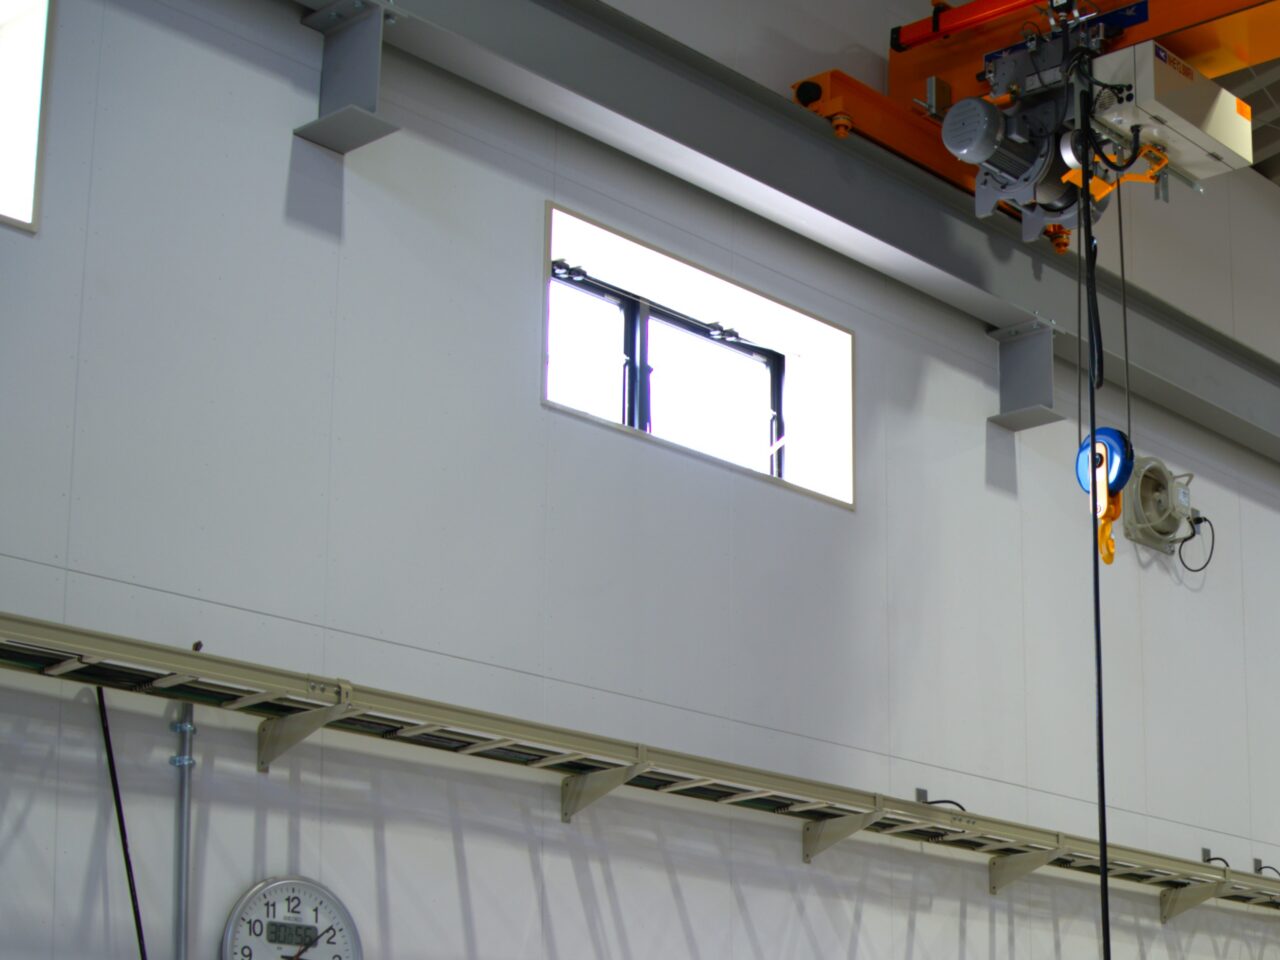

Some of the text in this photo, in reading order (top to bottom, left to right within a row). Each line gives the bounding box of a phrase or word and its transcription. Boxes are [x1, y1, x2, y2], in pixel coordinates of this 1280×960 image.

[264, 901, 276, 918] 11
[285, 896, 300, 914] 12
[313, 907, 318, 923] 1
[247, 919, 264, 937] 10
[326, 927, 337, 945] 2
